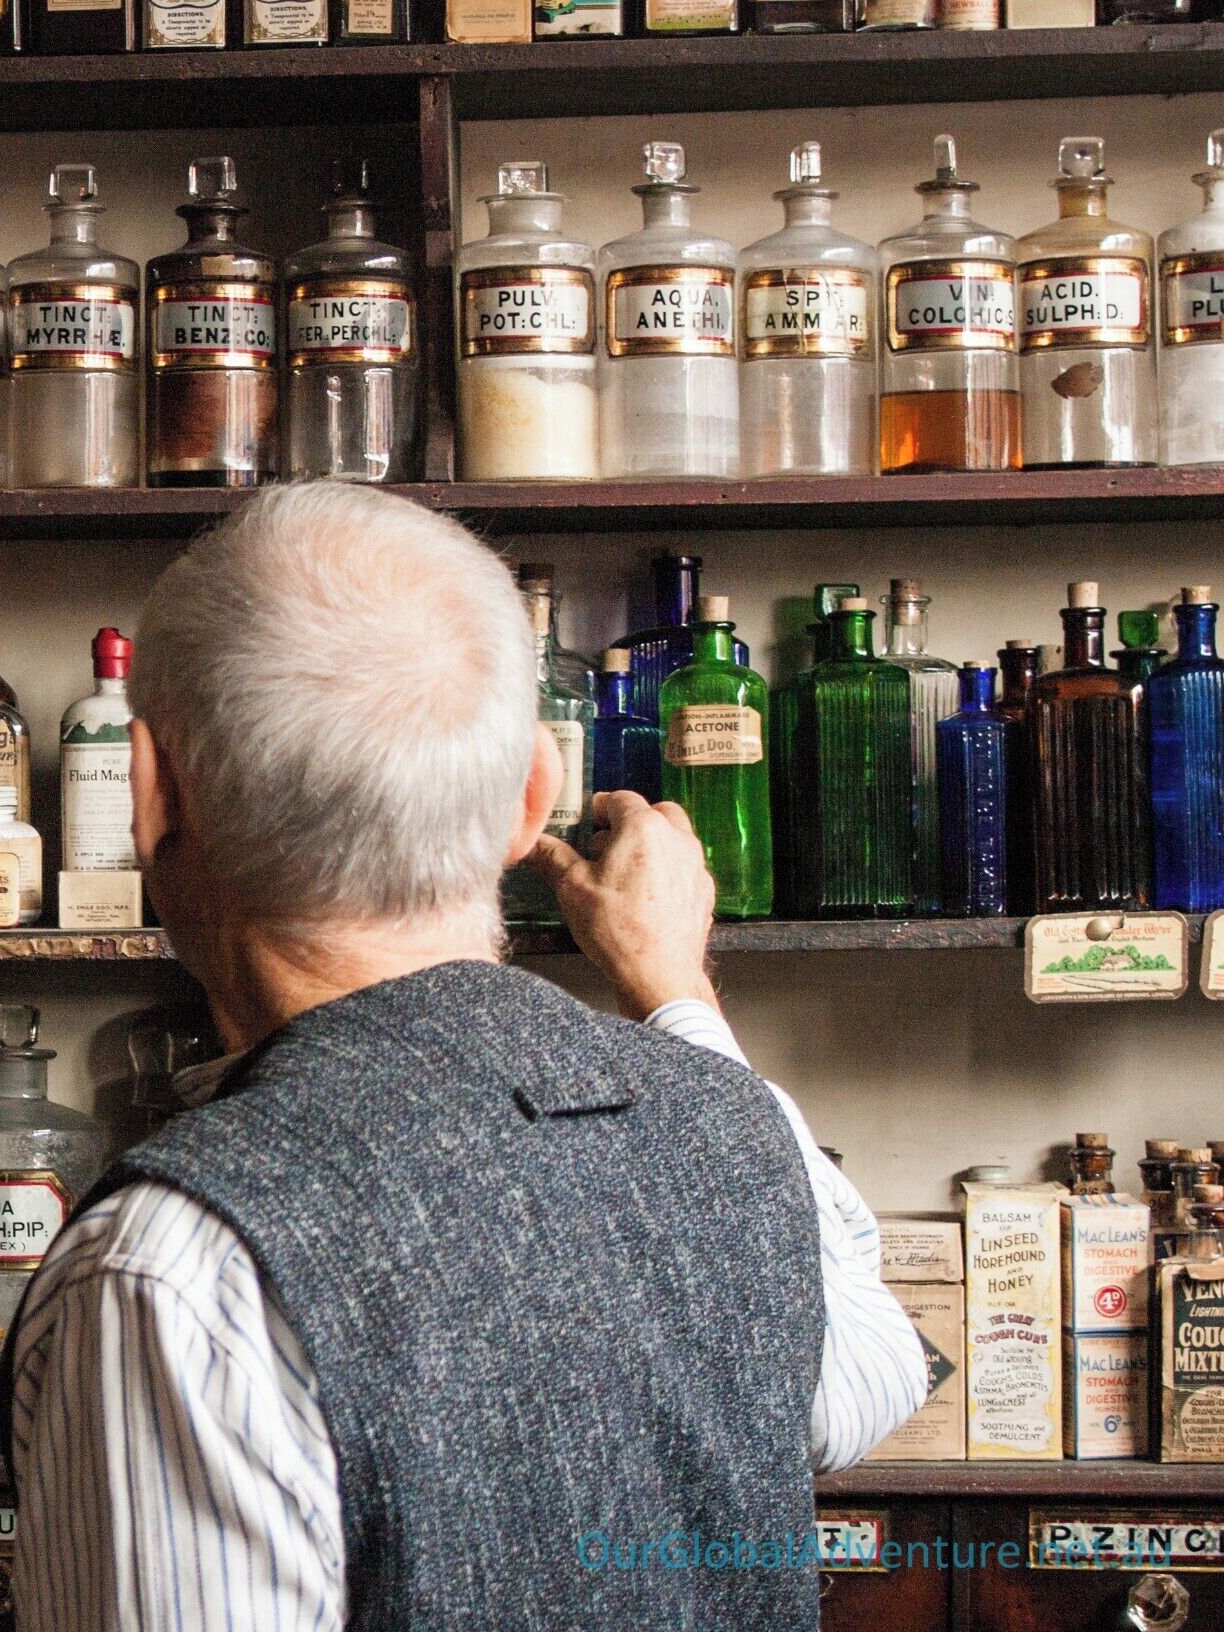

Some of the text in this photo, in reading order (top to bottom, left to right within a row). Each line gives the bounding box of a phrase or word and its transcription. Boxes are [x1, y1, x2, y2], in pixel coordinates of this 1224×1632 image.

[1040, 281, 1099, 301] ACID.
[498, 290, 558, 308] PULV:
[40, 307, 113, 325] TINCT:
[188, 305, 259, 324] TINCT:
[685, 722, 739, 733] ACETONE
[69, 770, 98, 781] Fluid
[982, 1213, 1031, 1223] BALSAM
[981, 1232, 1038, 1251] LINSEED
[1084, 1249, 1137, 1258] STOMACH
[973, 1250, 1046, 1269] HOREHOUND
[1007, 1267, 1023, 1275] AND
[1084, 1265, 1140, 1275] DIGESTIVE
[988, 1275, 1034, 1293] HONEY
[975, 1328, 1015, 1344] COUGH
[1086, 1376, 1139, 1387] STOMACH
[1086, 1394, 1139, 1405] DIGESTIVE
[980, 1422, 1029, 1431] SOOTHING
[989, 1432, 1040, 1440] DEMULCENT
